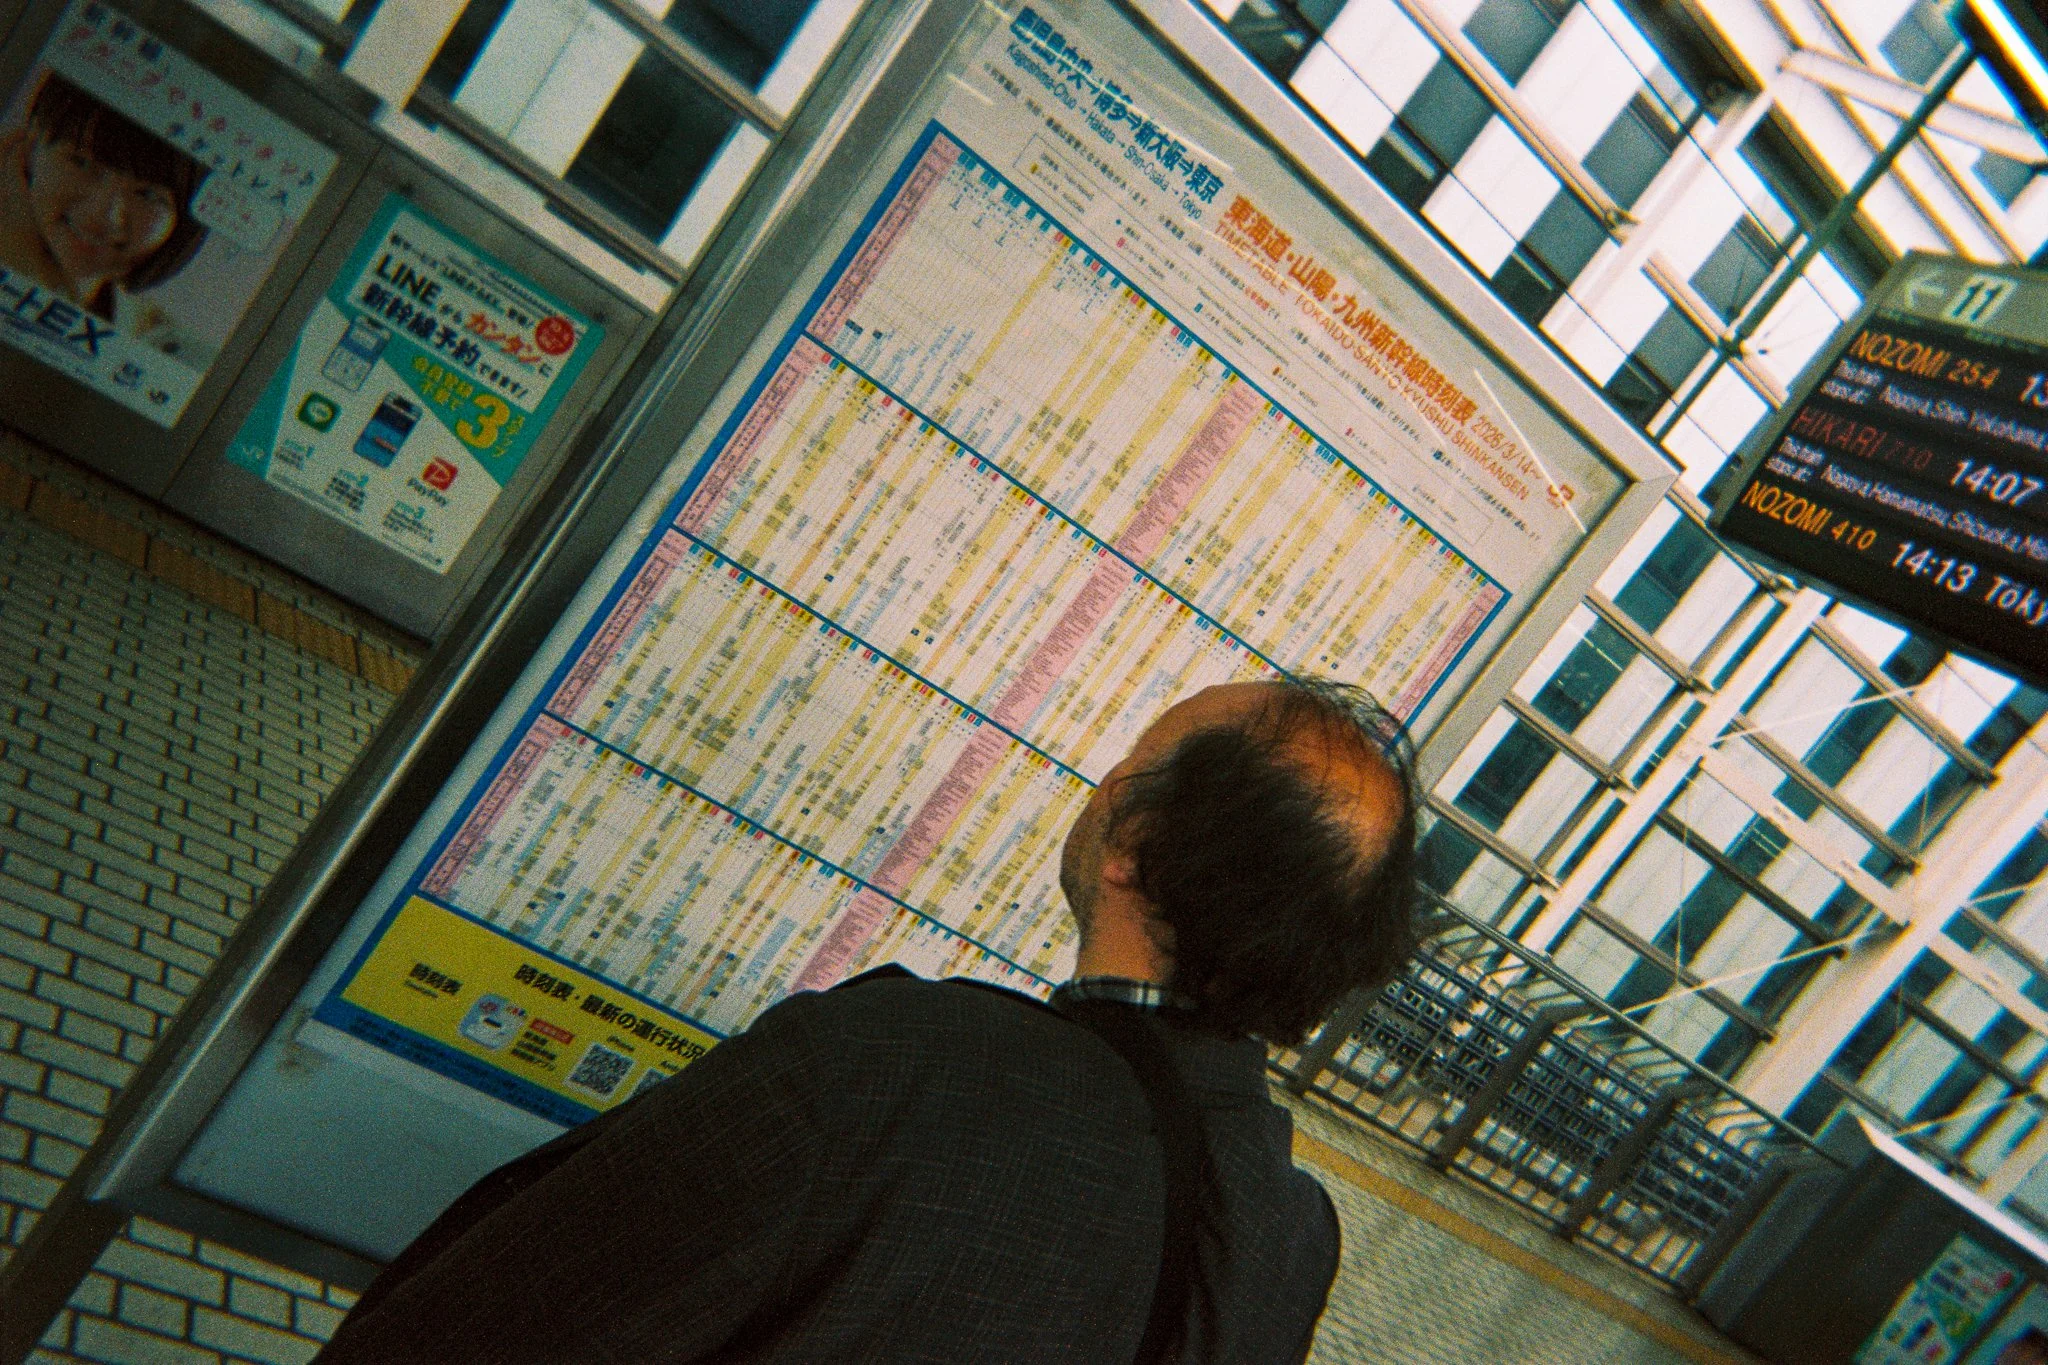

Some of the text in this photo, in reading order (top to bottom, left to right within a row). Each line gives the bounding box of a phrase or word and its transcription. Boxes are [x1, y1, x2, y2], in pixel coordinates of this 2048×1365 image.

[1178, 191, 1204, 219] Tokyo
[1184, 161, 1224, 205] 東京
[1952, 280, 2003, 321] 11
[1848, 330, 1951, 378] NOZOMI
[1946, 358, 2000, 390] 254
[457, 396, 510, 448] 3
[1793, 405, 1888, 459] HIKARI
[1949, 457, 2045, 507] 14:07
[1741, 480, 1832, 537] NOZOMI
[1831, 519, 1878, 551] 410
[1890, 539, 1978, 593] 14:13
